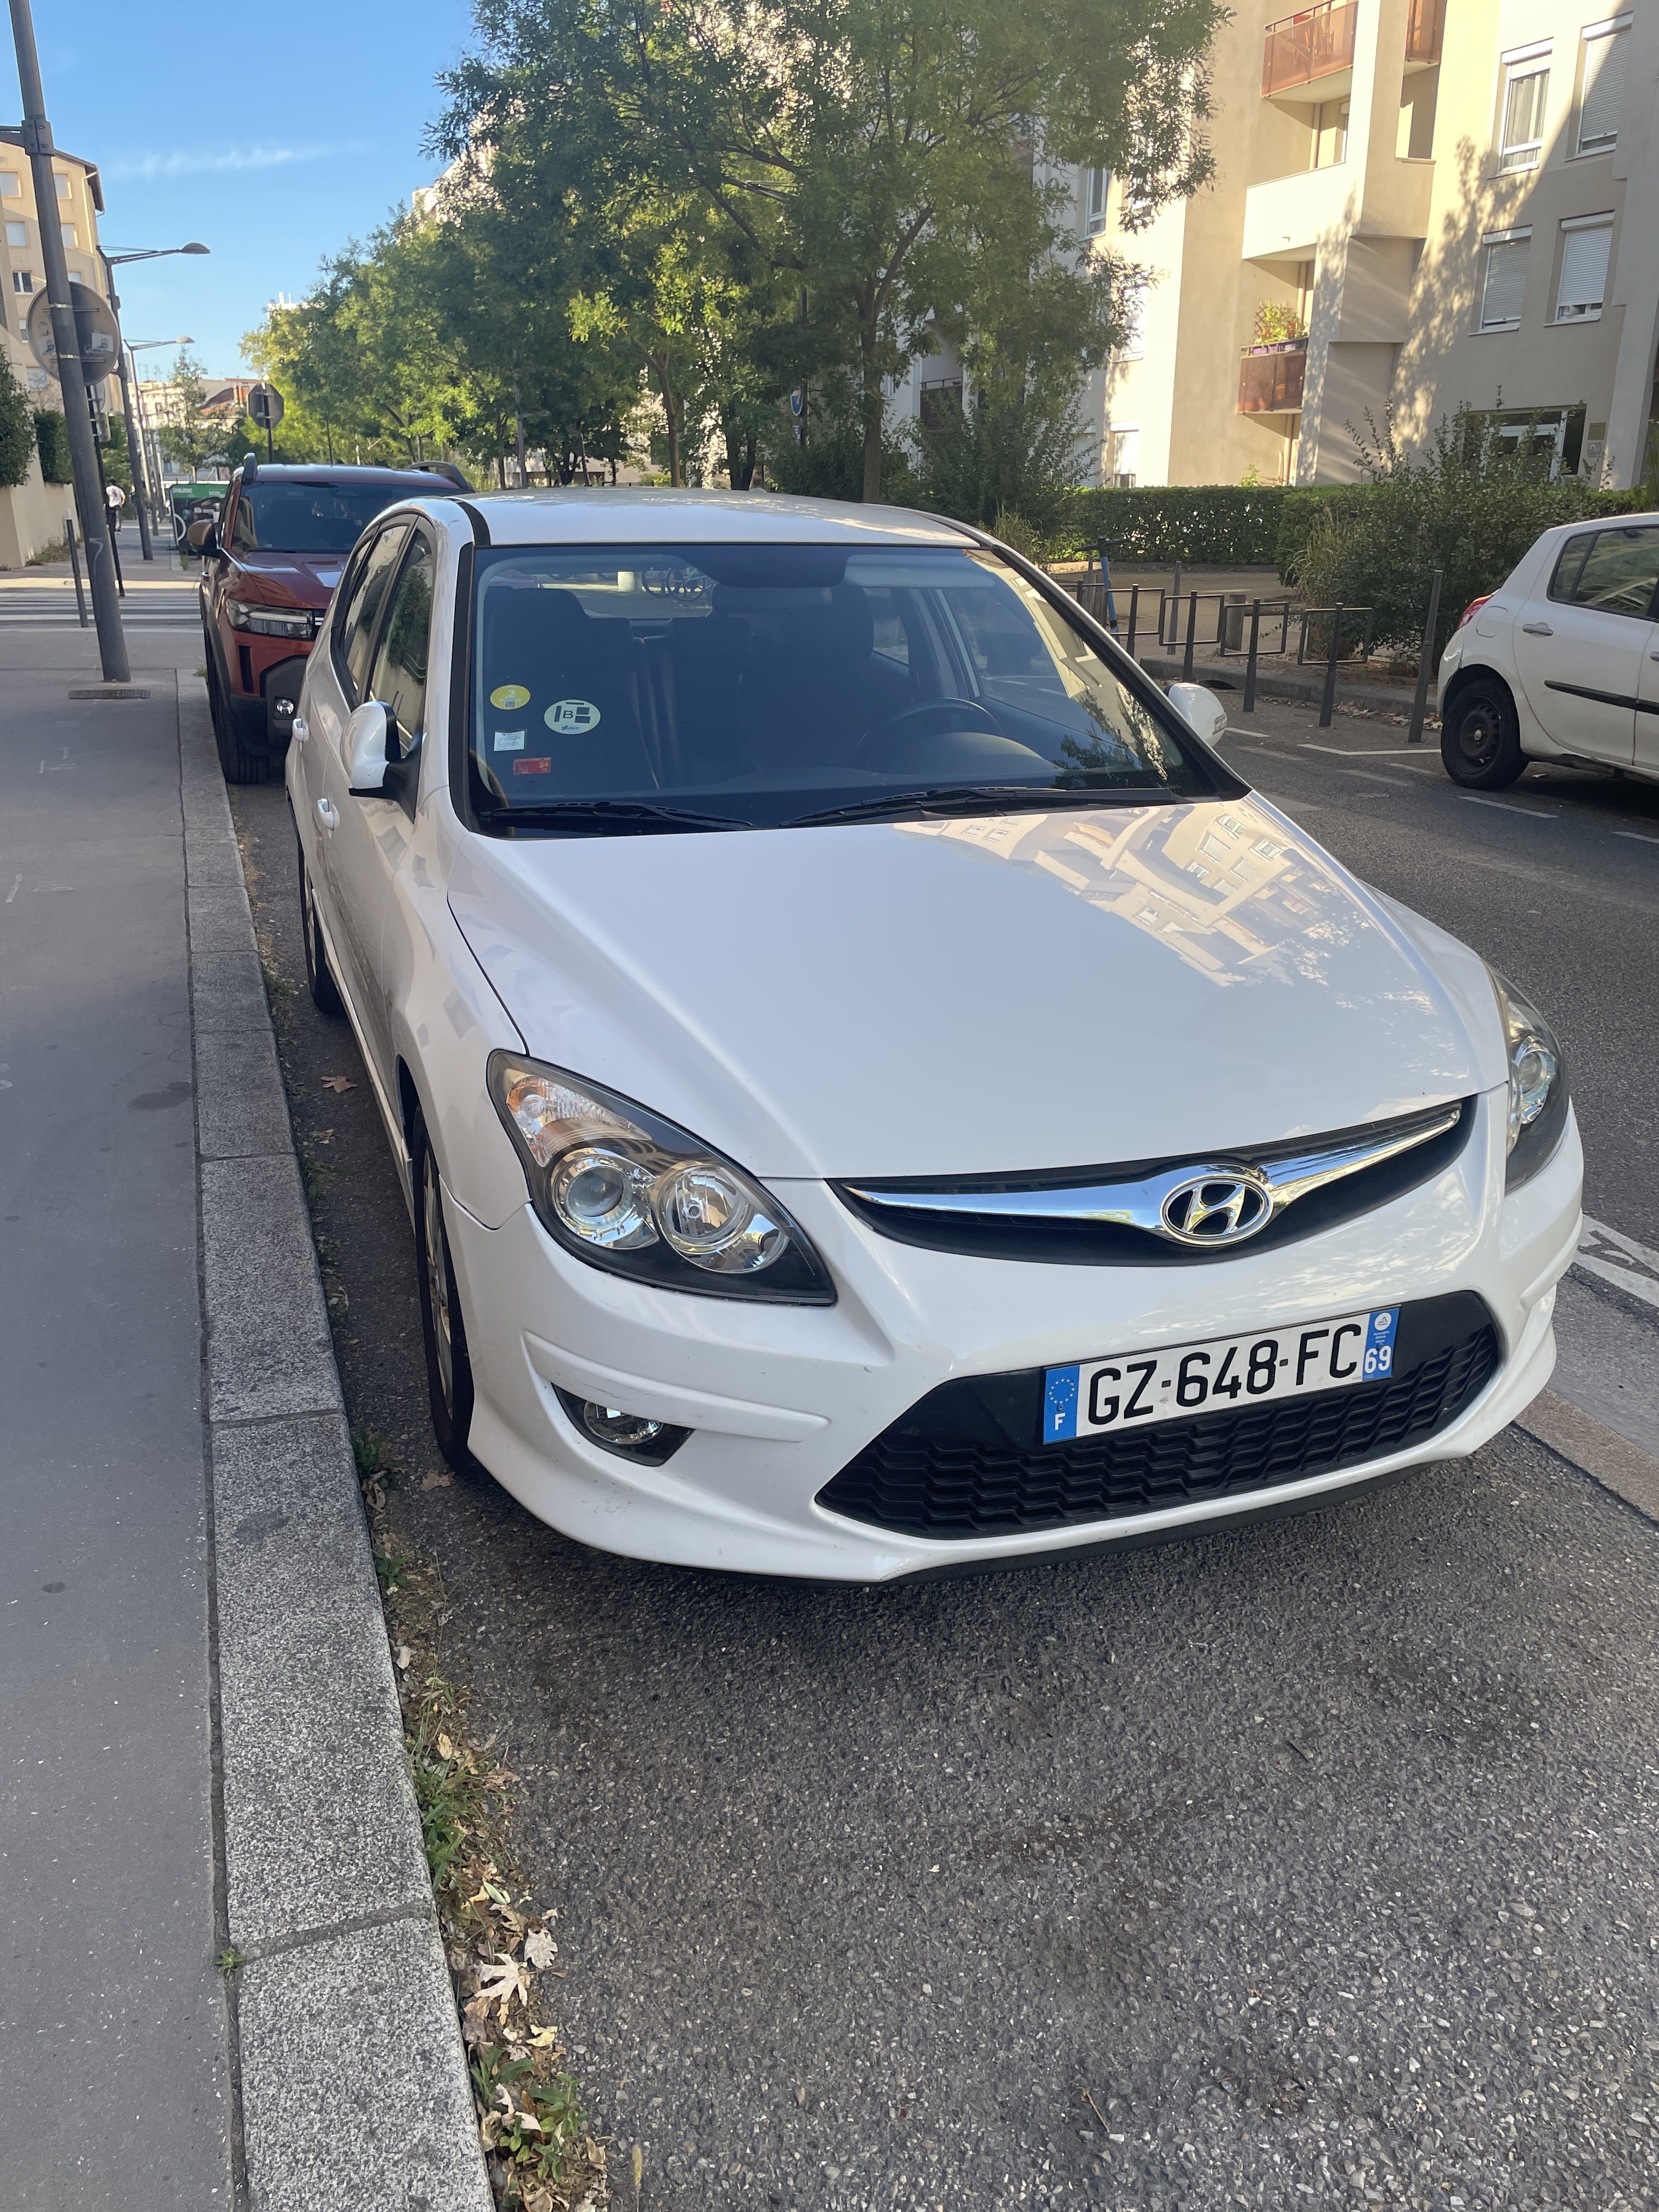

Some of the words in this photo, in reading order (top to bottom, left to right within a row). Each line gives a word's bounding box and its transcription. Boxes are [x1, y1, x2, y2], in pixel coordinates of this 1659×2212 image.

[505, 689, 516, 698] 2
[563, 710, 573, 719] B
[1364, 1345, 1392, 1374] 69
[1087, 1323, 1362, 1425] GZ-648-FC
[1054, 1413, 1066, 1430] F
